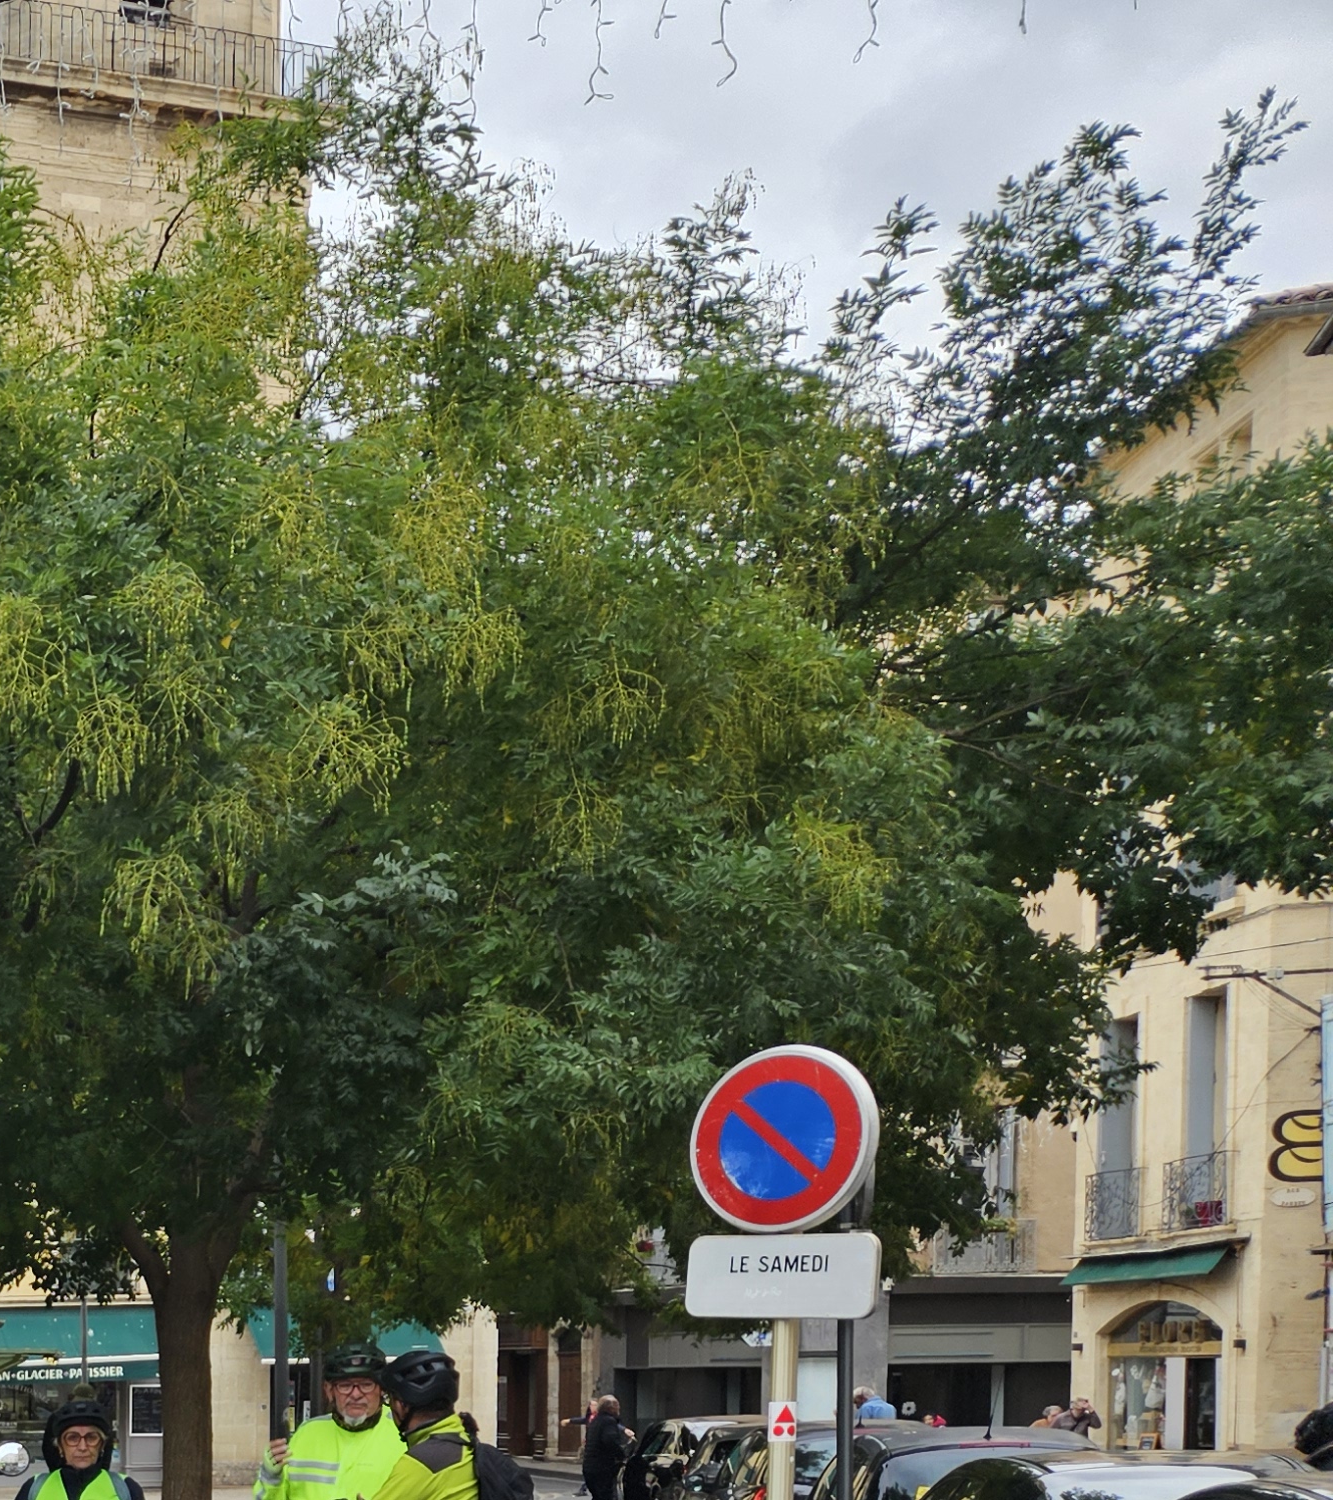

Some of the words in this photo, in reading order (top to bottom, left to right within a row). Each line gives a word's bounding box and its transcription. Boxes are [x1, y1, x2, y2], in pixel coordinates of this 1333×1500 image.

[729, 1255, 750, 1274] LE
[757, 1254, 830, 1273] SAMEDI
[16, 1367, 64, 1381] GLACIER
